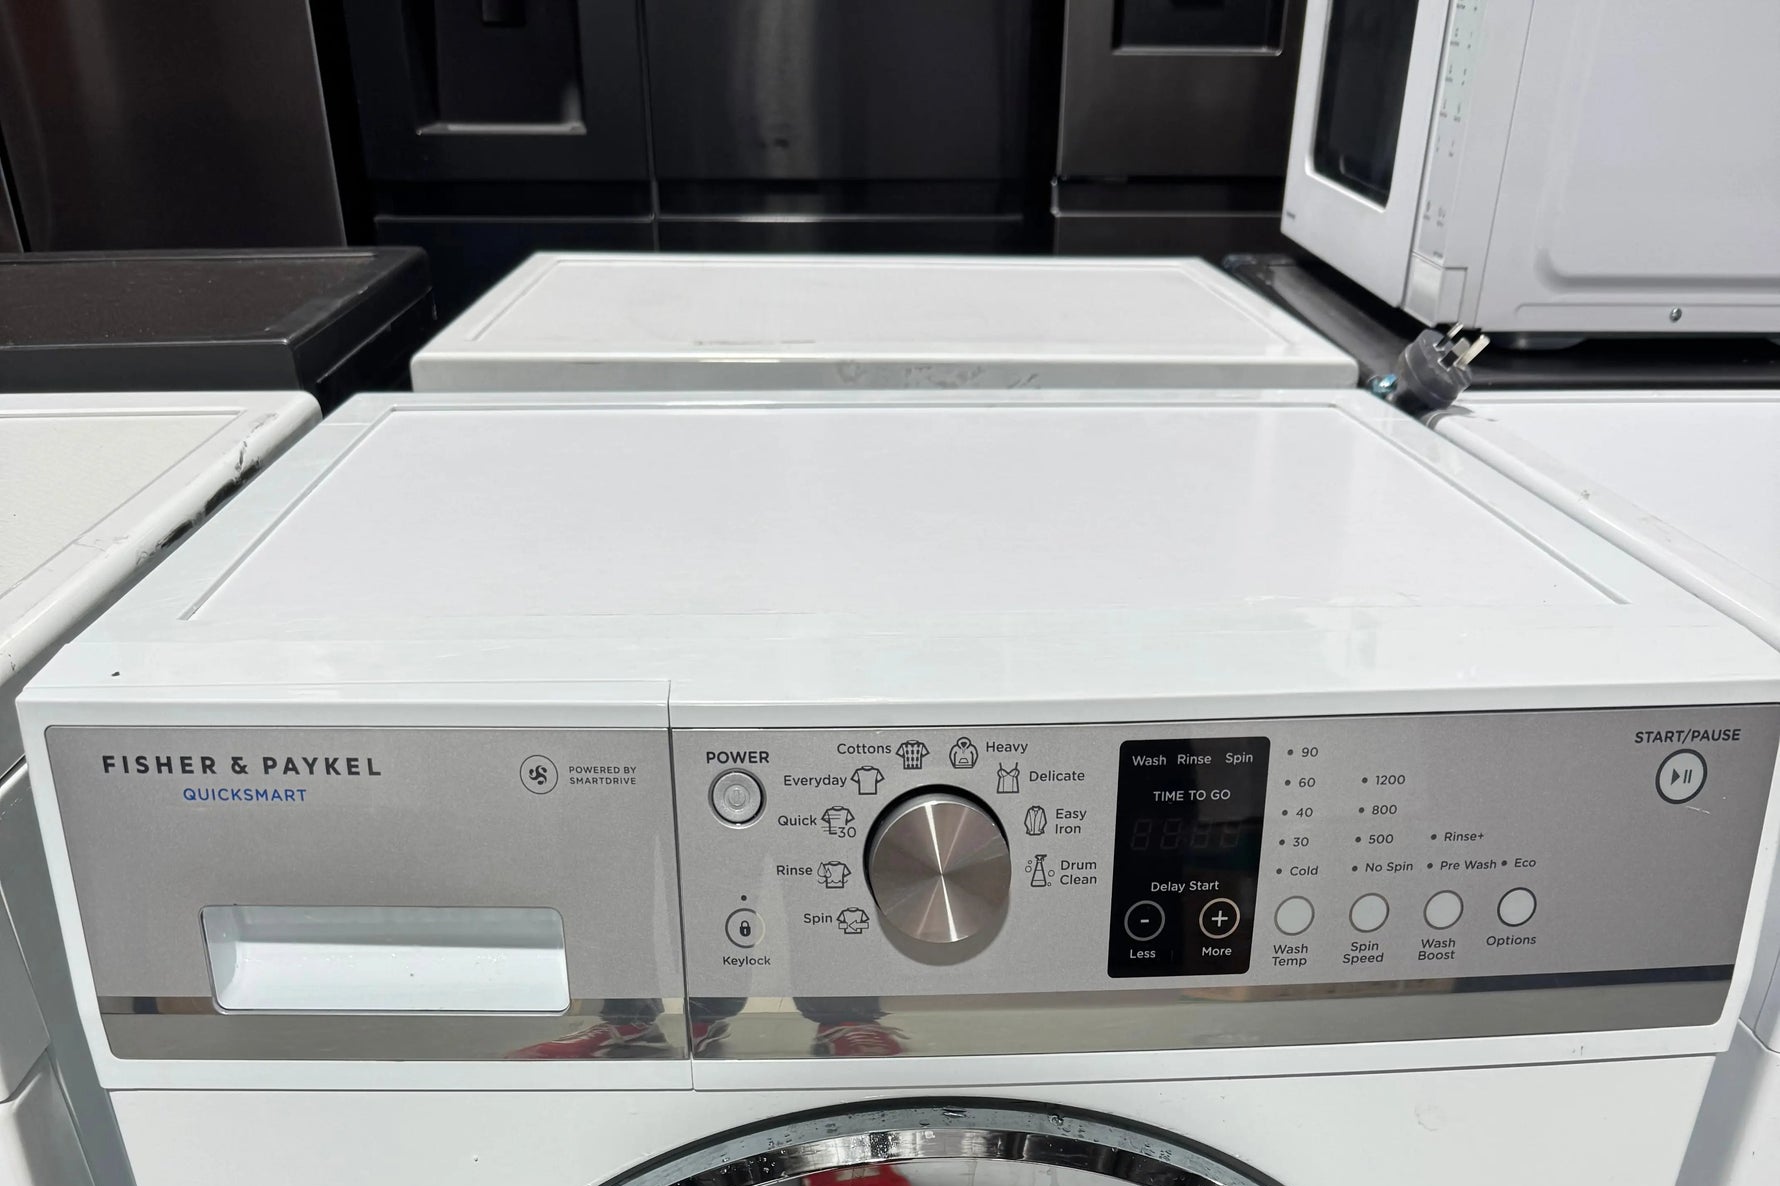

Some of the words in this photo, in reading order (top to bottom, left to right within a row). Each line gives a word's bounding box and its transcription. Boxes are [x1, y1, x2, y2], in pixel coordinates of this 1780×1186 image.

[1635, 729, 1741, 744] START/PAUSE
[837, 743, 891, 754] Cottons
[987, 742, 1028, 754] Heavy
[1302, 747, 1318, 757] 90
[707, 751, 769, 764] POWER
[1132, 755, 1166, 766] Wash
[1178, 754, 1211, 764] Rinse
[1226, 752, 1253, 765] Spin
[102, 756, 216, 774] FISHER
[231, 757, 248, 774] &
[263, 757, 381, 775] PAYKEL
[784, 775, 847, 787] Everyday
[1030, 770, 1084, 781] Delicate
[1376, 775, 1405, 785] 1200
[1299, 778, 1315, 787] 60
[183, 788, 306, 801] QUICKSMART
[1153, 791, 1184, 801] TIME
[1189, 790, 1206, 800] TO
[1211, 790, 1230, 800] GO
[1056, 809, 1086, 820] Easy
[1296, 808, 1313, 817] 40
[1372, 805, 1397, 815] 800
[778, 815, 817, 826] Quick
[838, 827, 857, 838] 30
[1056, 824, 1081, 834] Iron
[1293, 837, 1309, 847] 30
[1369, 834, 1393, 844] 500
[1444, 832, 1484, 841] Rinse+
[1061, 860, 1096, 870] Drum
[1366, 863, 1382, 872] No
[1387, 862, 1413, 873] Spin
[1441, 861, 1460, 870] Pre
[1465, 860, 1496, 869] Wash
[1515, 858, 1536, 867] Eco
[777, 865, 812, 875] Rinse
[1290, 866, 1318, 876] Cold
[1060, 875, 1096, 885] Clean
[1151, 882, 1185, 893] Delay
[1189, 881, 1219, 890] Start
[804, 913, 832, 925] Spin
[1421, 938, 1456, 949] Wash
[1487, 935, 1536, 947] Options
[1202, 947, 1231, 955] More
[1274, 944, 1308, 954] Wash
[1350, 941, 1379, 953] Spin
[1130, 949, 1155, 958] Less
[1343, 953, 1384, 965] Speed
[1418, 950, 1455, 960] Boost
[723, 956, 770, 967] Keylock
[1272, 957, 1307, 967] Temp
